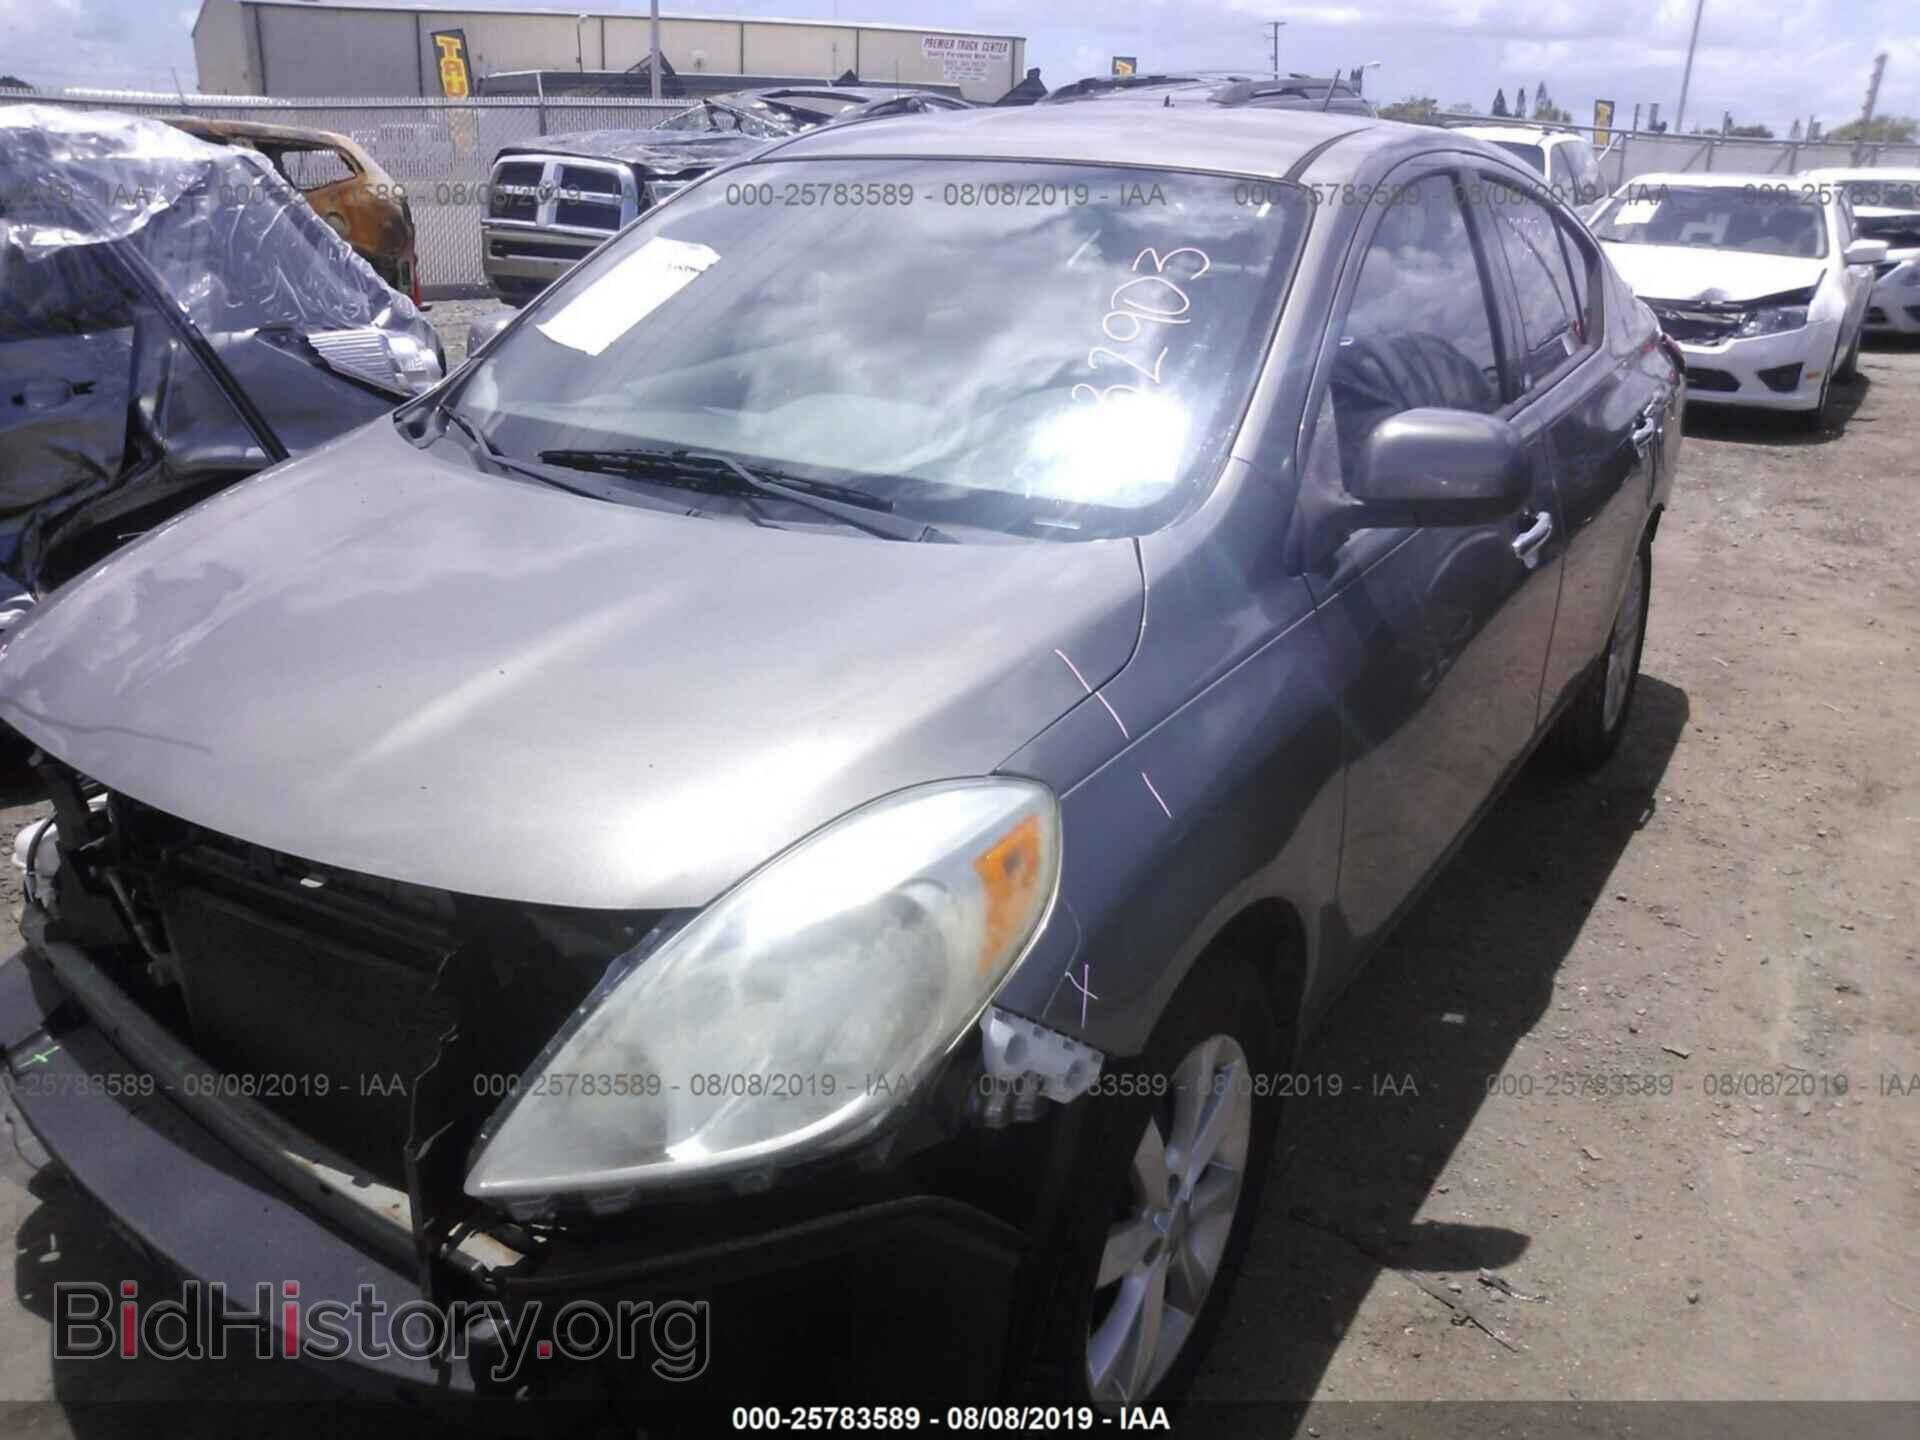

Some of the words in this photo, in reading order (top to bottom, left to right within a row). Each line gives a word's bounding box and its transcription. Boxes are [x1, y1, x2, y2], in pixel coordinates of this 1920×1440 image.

[923, 38, 955, 50] PREMIER
[956, 39, 978, 51] TRUCK
[981, 41, 1009, 54] CENTER
